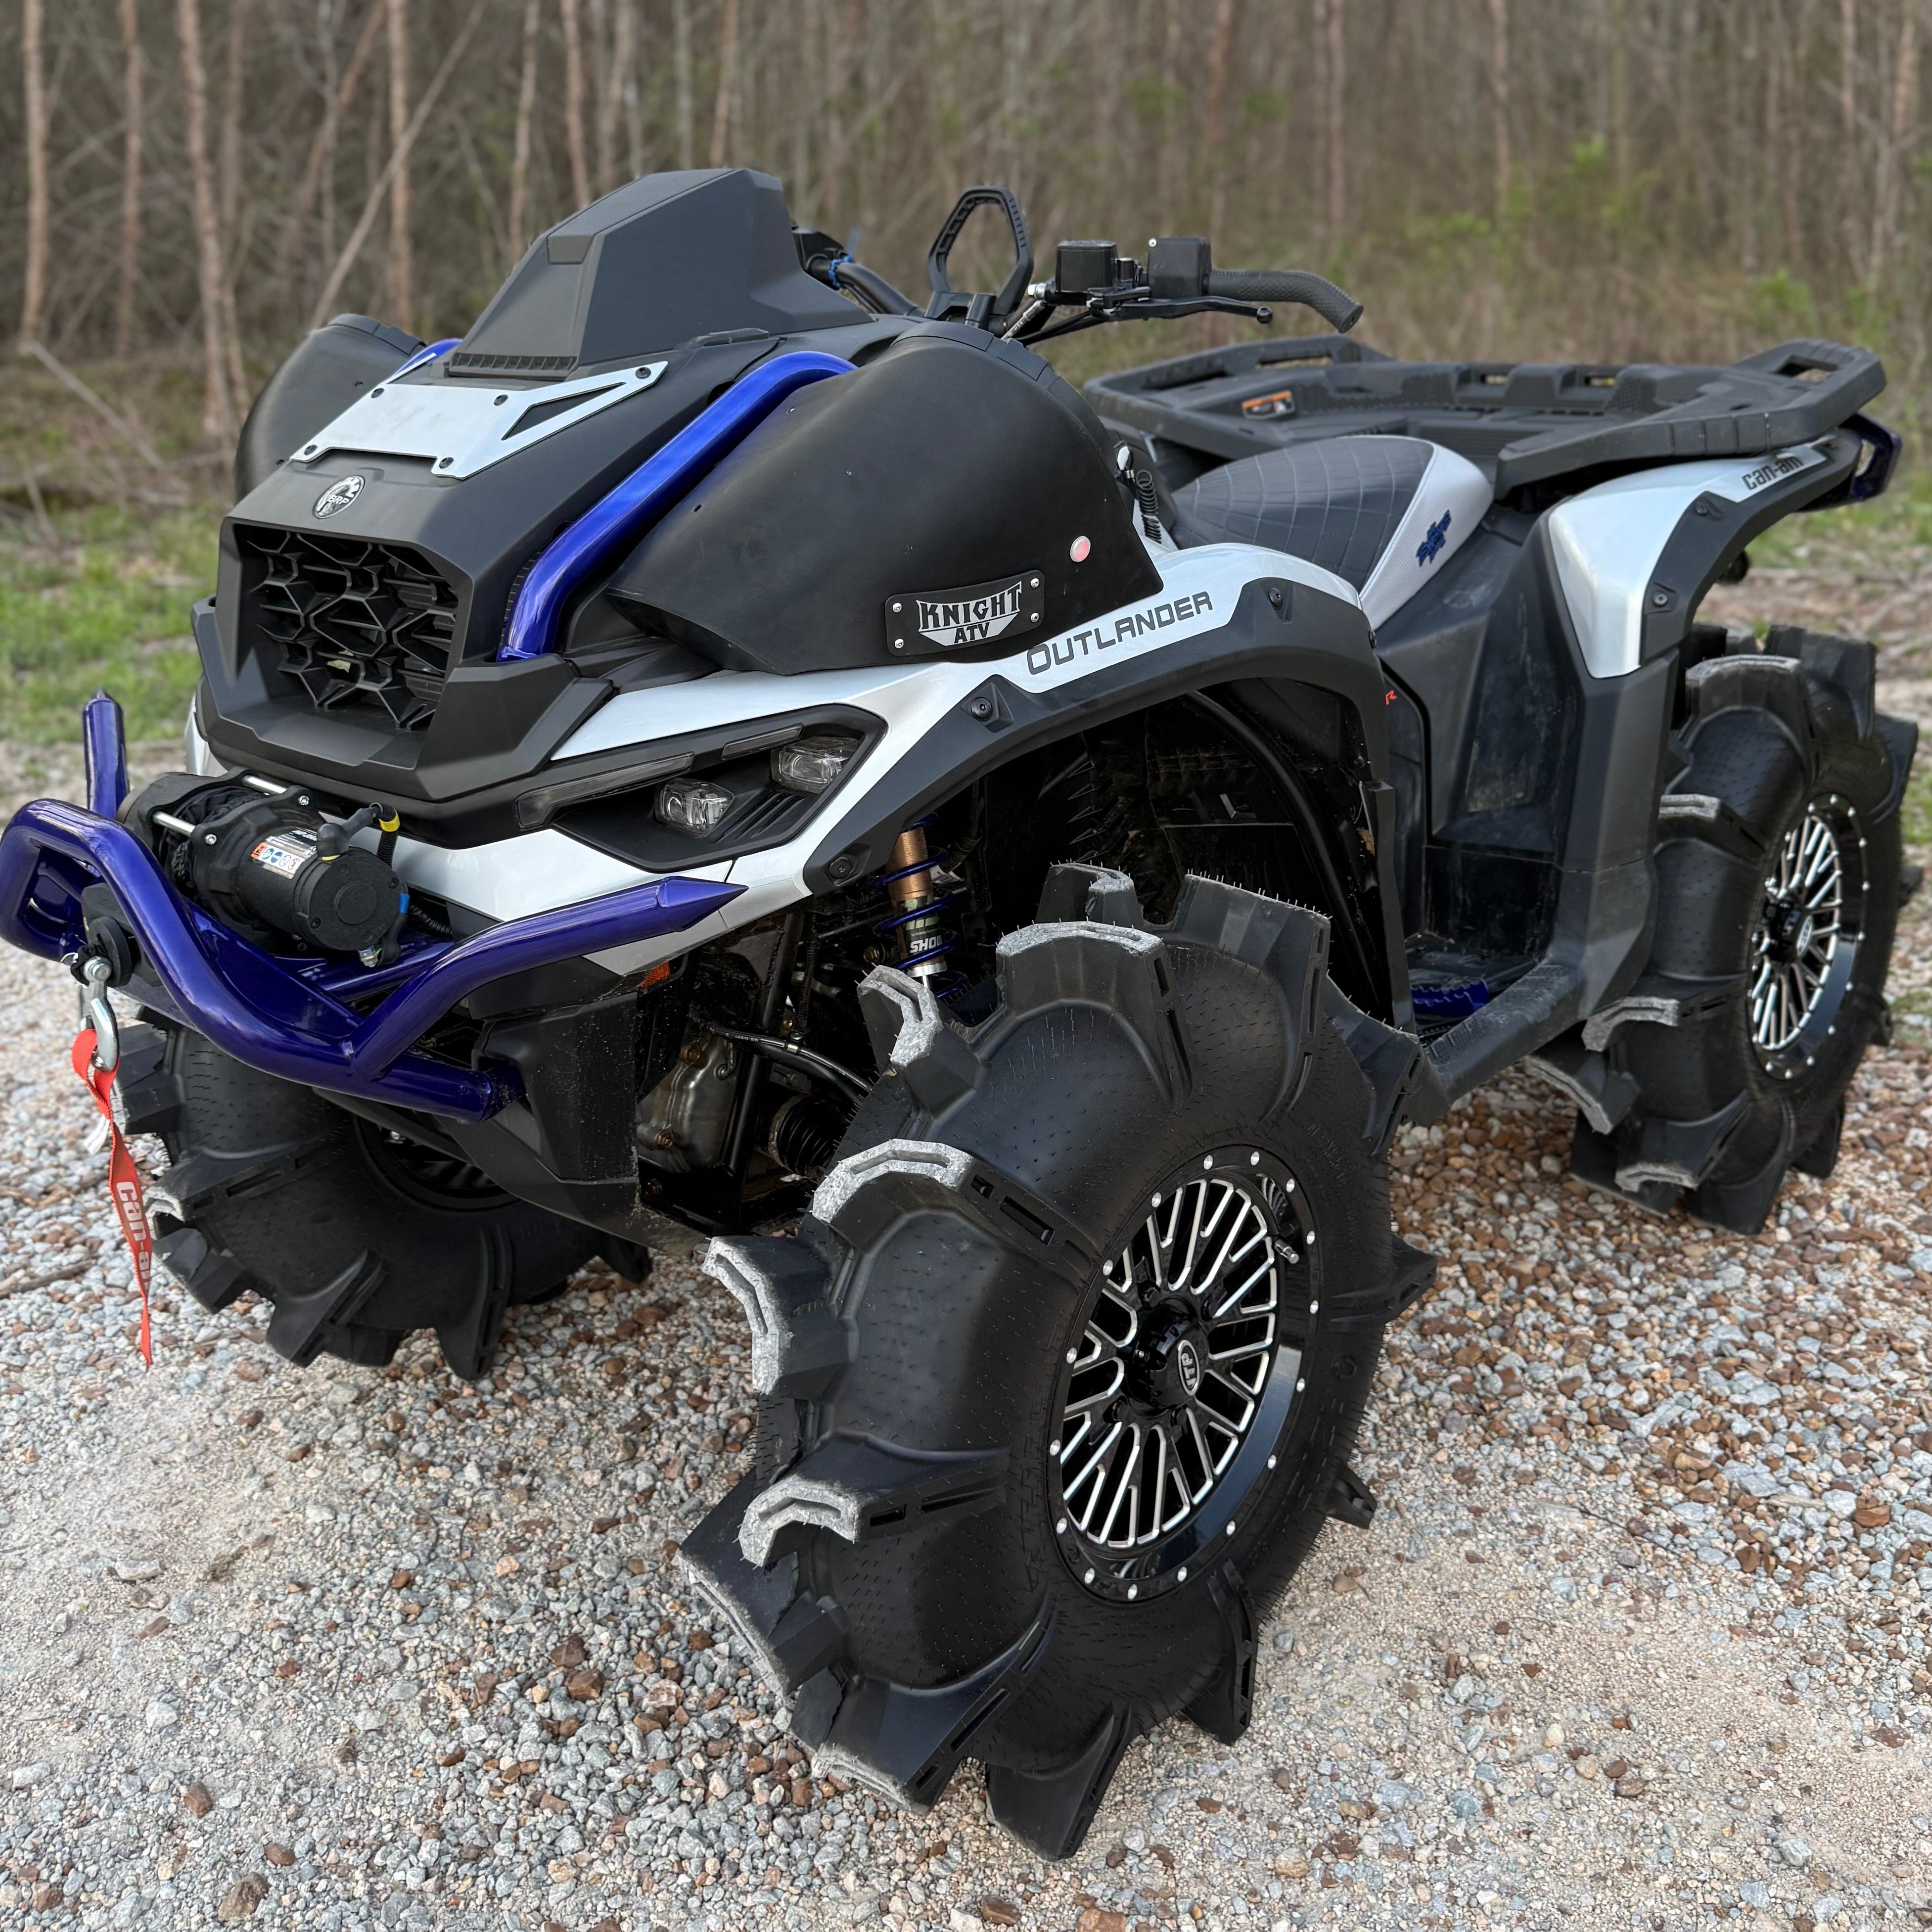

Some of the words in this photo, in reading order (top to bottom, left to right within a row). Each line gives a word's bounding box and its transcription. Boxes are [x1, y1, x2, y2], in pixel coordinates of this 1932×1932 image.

[1742, 457, 1804, 490] can-am
[328, 496, 349, 505] BRP
[919, 583, 1022, 630] KNIGHT
[954, 622, 990, 644] ATV
[1026, 591, 1213, 675] OUTLANDER
